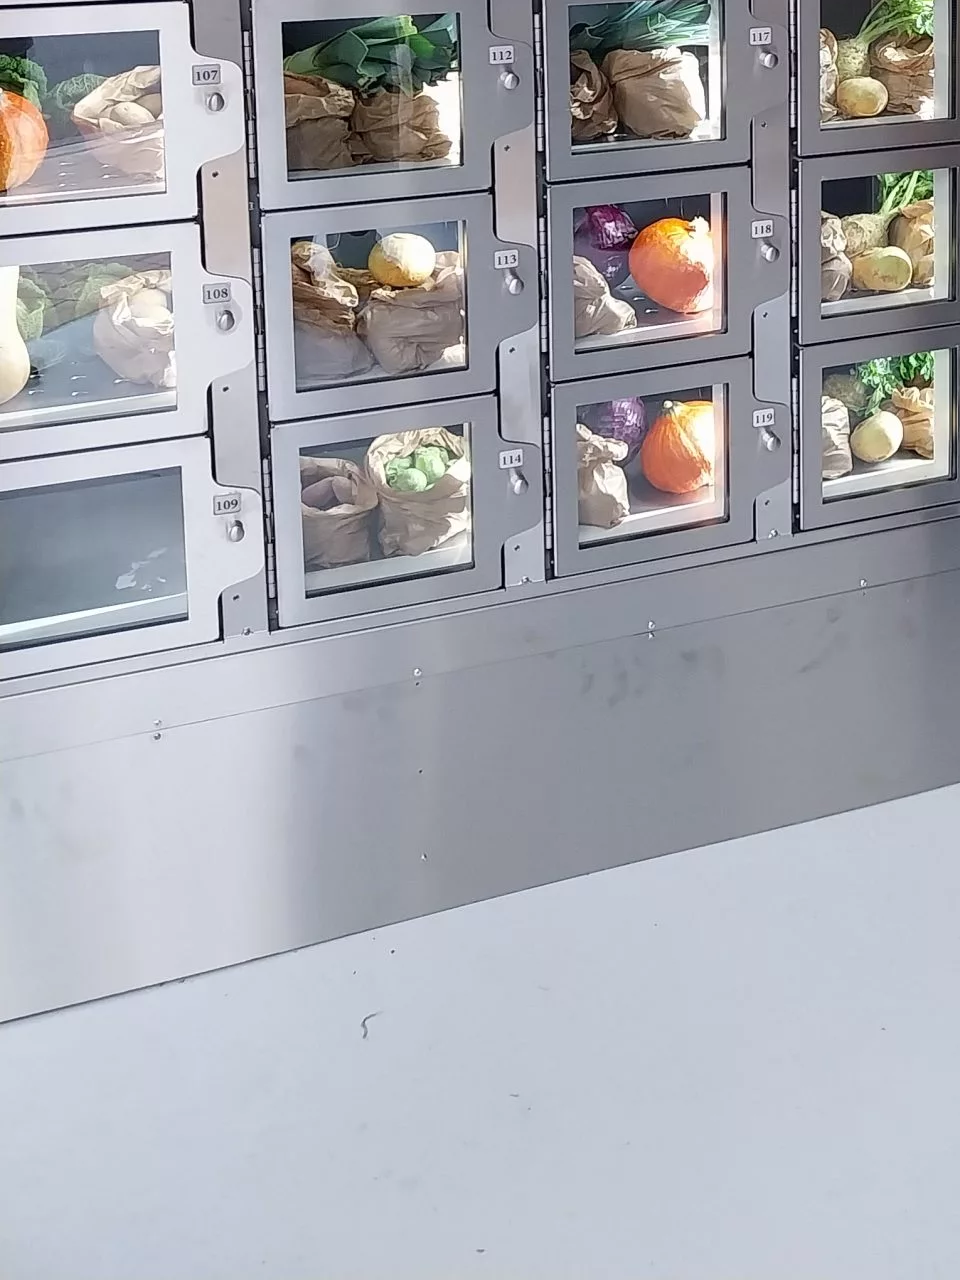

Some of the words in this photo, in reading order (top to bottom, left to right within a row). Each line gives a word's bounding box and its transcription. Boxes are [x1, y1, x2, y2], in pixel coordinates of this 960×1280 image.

[751, 31, 770, 42] 117
[491, 50, 512, 61] 112
[195, 69, 218, 82] 107
[753, 224, 772, 235] 118
[496, 254, 517, 265] 113
[205, 288, 229, 300] 108
[755, 413, 773, 424] 119
[502, 453, 521, 465] 114
[216, 498, 238, 511] 109
